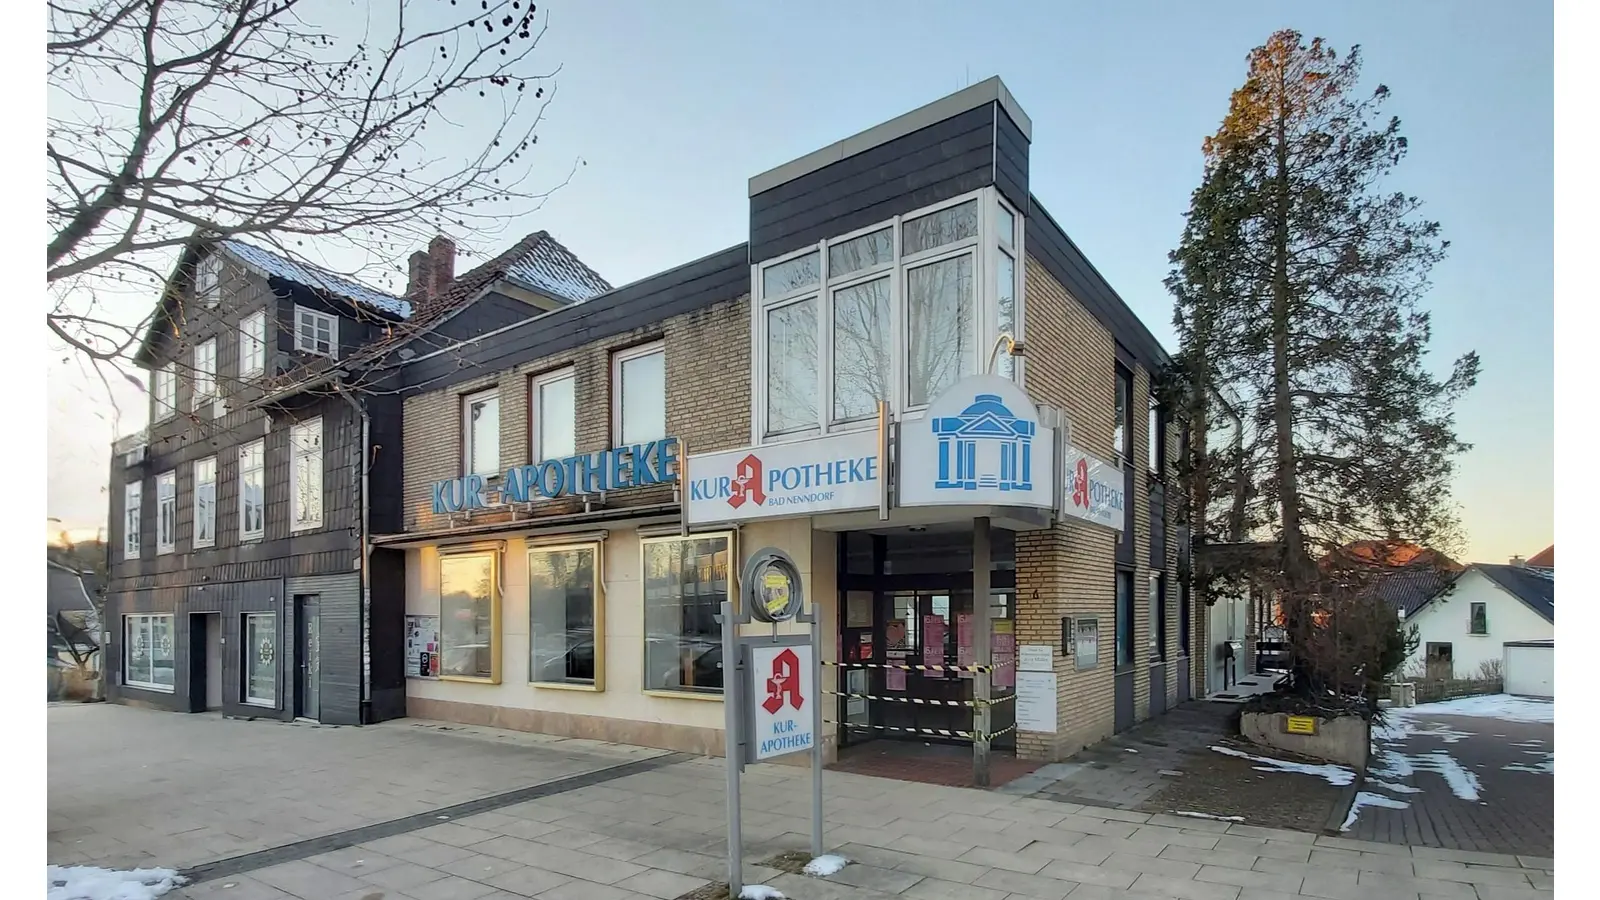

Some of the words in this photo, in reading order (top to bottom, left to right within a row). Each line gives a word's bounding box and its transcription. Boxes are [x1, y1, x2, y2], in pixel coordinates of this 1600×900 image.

[690, 476, 730, 501] KUR
[768, 496, 786, 507] BAD
[786, 491, 835, 506] NENNDORF
[773, 720, 798, 734] KUR-
[760, 732, 811, 754] APOTHEKE
